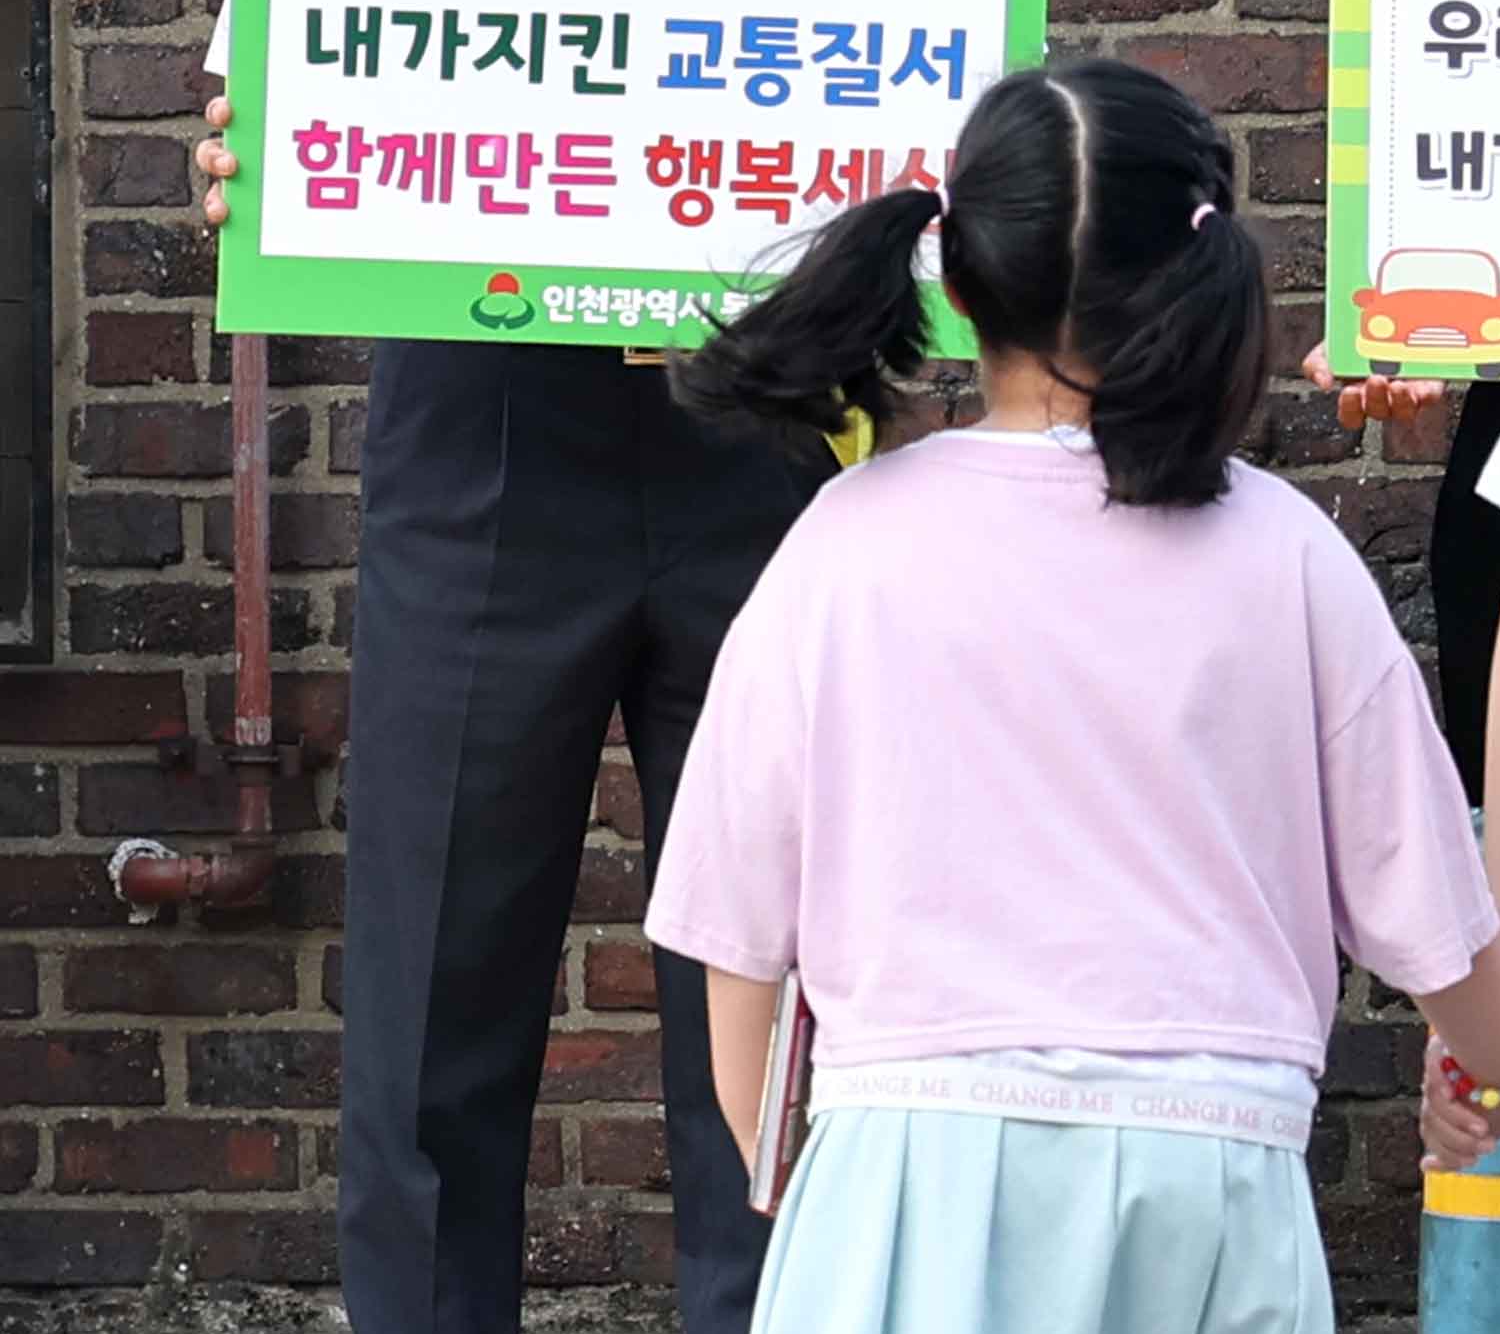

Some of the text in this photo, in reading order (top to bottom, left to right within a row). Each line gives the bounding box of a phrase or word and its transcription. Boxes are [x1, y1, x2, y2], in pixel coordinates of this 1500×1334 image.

[304, 6, 968, 108] 내가지킨 교통질서
[292, 119, 618, 218] 함께만든
[543, 284, 711, 328] 인천광역시
[969, 1081, 1072, 1109] CHANGE
[1079, 1089, 1113, 1115] ME
[1131, 1097, 1228, 1126] CHANGE
[1231, 1106, 1263, 1132] ME
